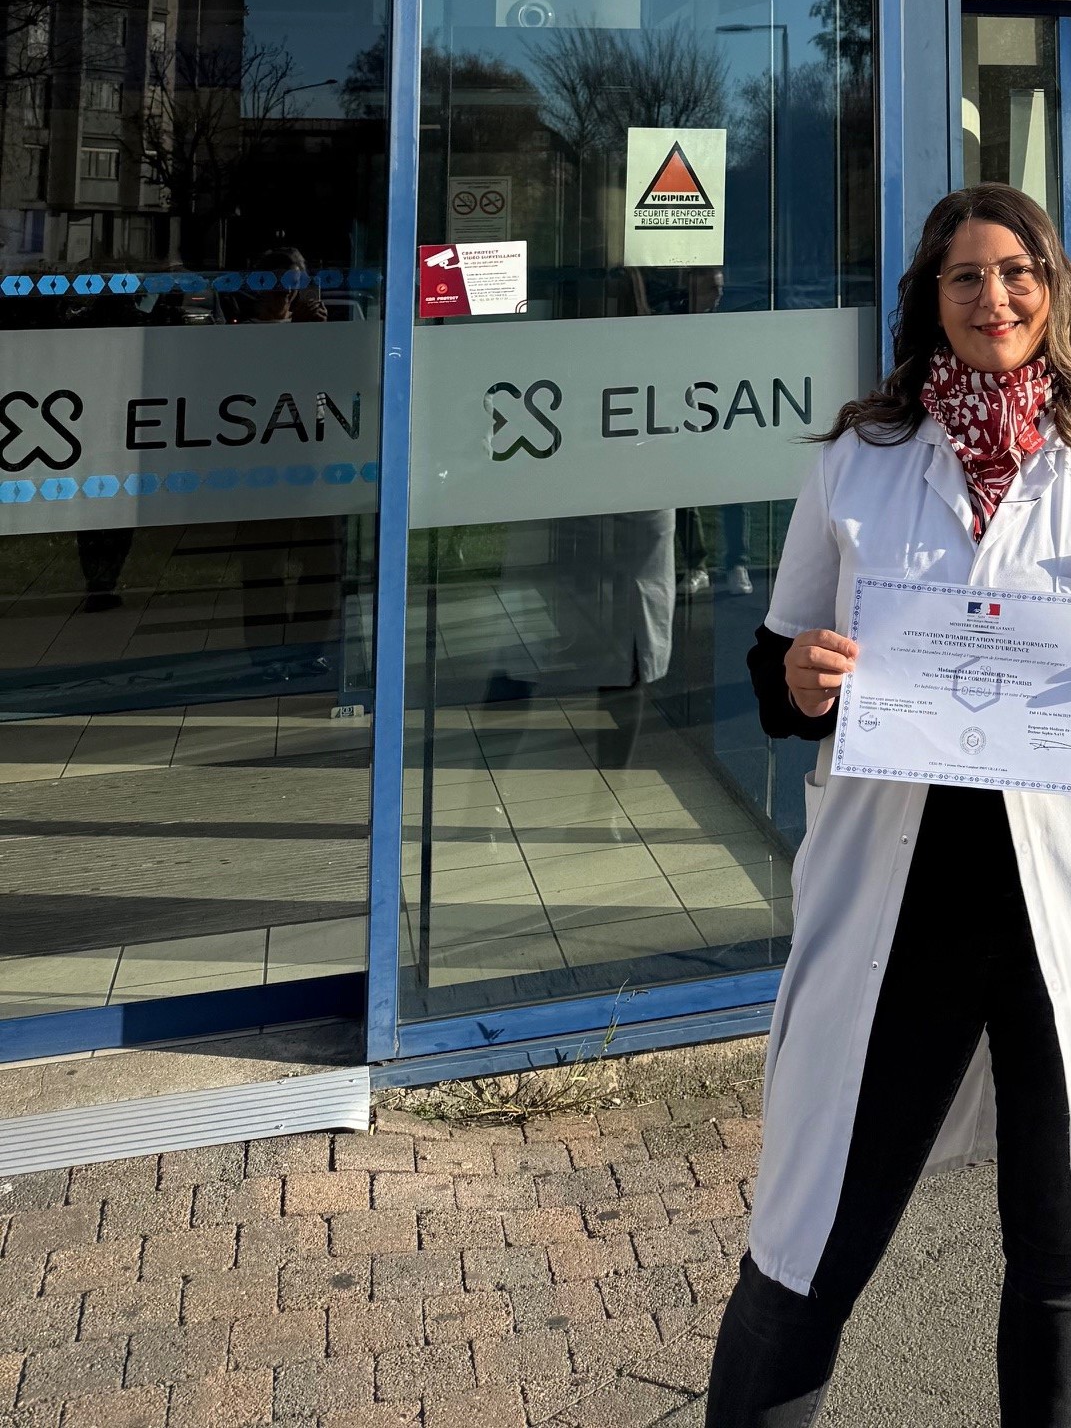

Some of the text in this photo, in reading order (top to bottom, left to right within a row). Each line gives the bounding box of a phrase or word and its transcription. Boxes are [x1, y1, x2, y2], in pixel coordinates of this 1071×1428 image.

[651, 194, 700, 202] VIGIPIRATE
[602, 376, 812, 438] ELSAN
[125, 391, 361, 450] ELSAN
[902, 630, 944, 639] ATTESTATION
[945, 633, 995, 643] D'HABILITATION
[995, 637, 1014, 645] POUR
[1022, 639, 1059, 649] FORMATION
[943, 640, 967, 648] GESTES
[995, 644, 1030, 653] D'URGENCE
